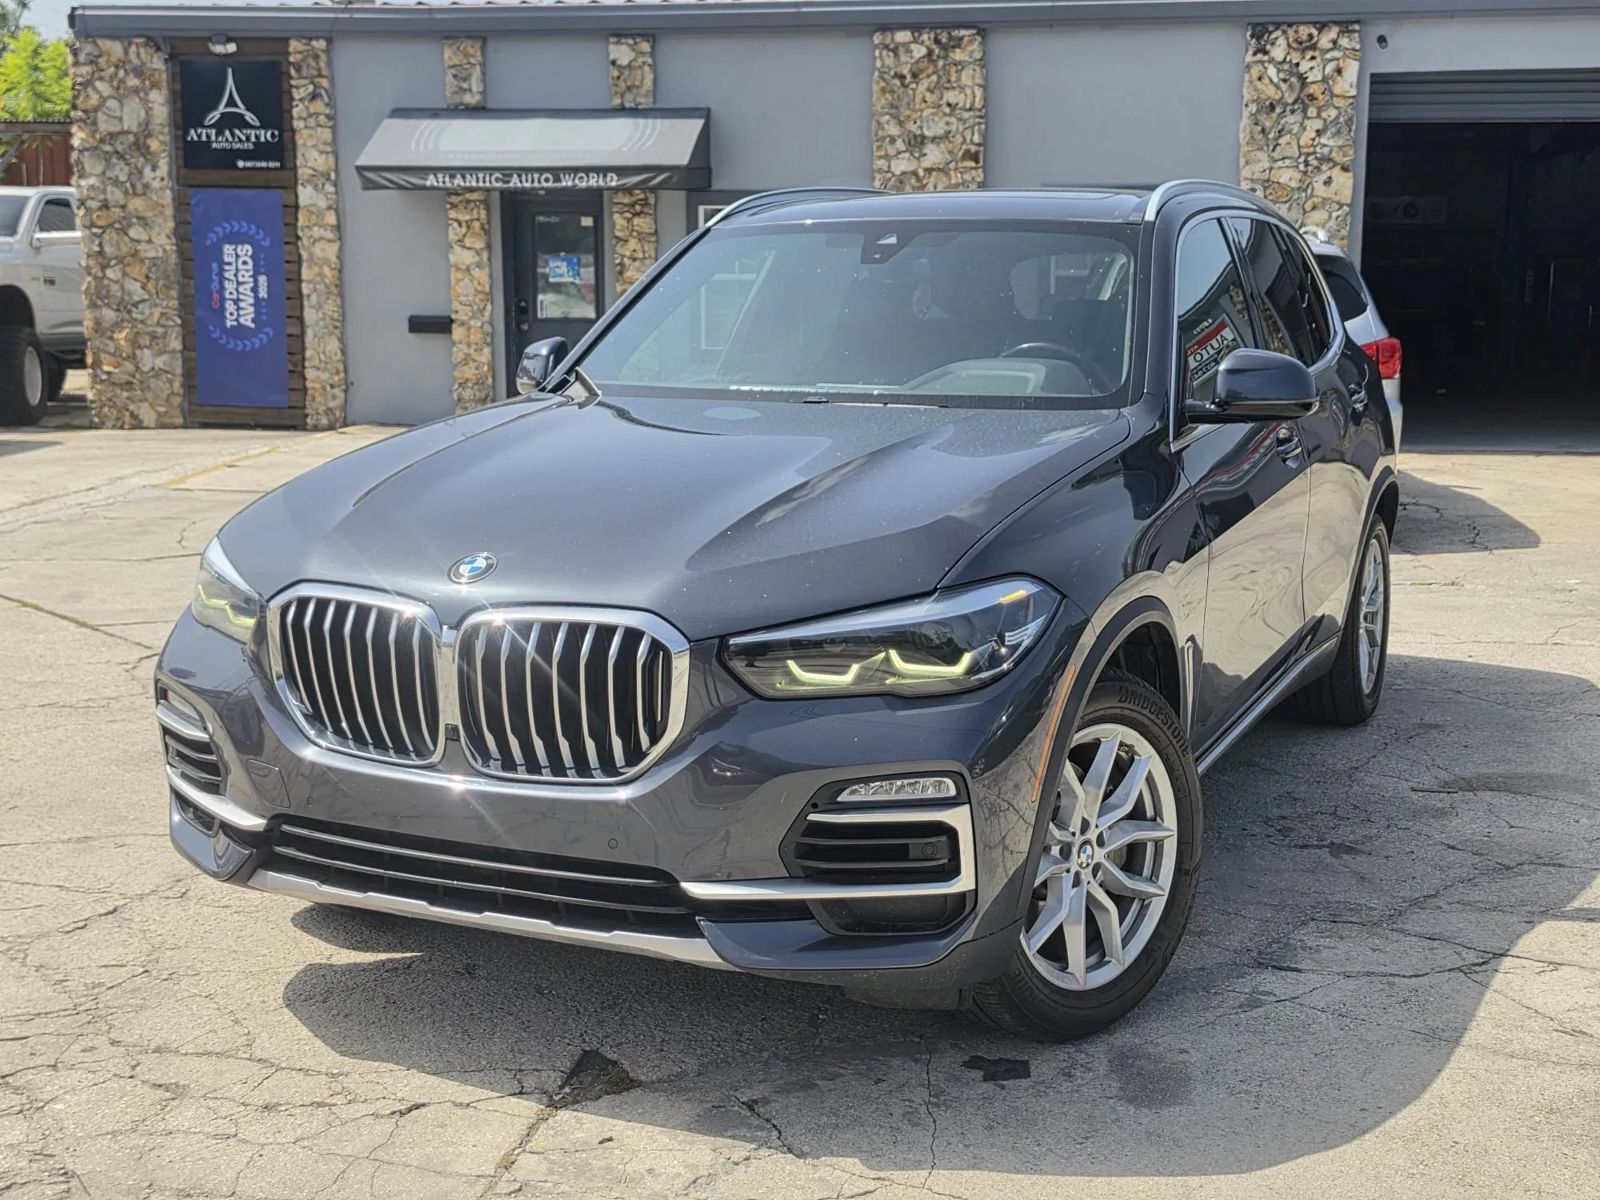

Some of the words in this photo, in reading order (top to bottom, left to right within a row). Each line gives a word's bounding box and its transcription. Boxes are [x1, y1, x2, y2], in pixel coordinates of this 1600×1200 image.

[186, 127, 280, 143] ATLANTIC
[211, 142, 231, 150] AUTO
[232, 142, 255, 150] SALES
[426, 172, 503, 187] ATLANTIC
[509, 172, 552, 187] AUTO
[559, 172, 618, 187] WORLD
[223, 244, 237, 300] DEALER
[236, 244, 255, 328] AWARDS
[225, 300, 238, 328] TOP
[1117, 685, 1189, 758] BRIDGESTONE
